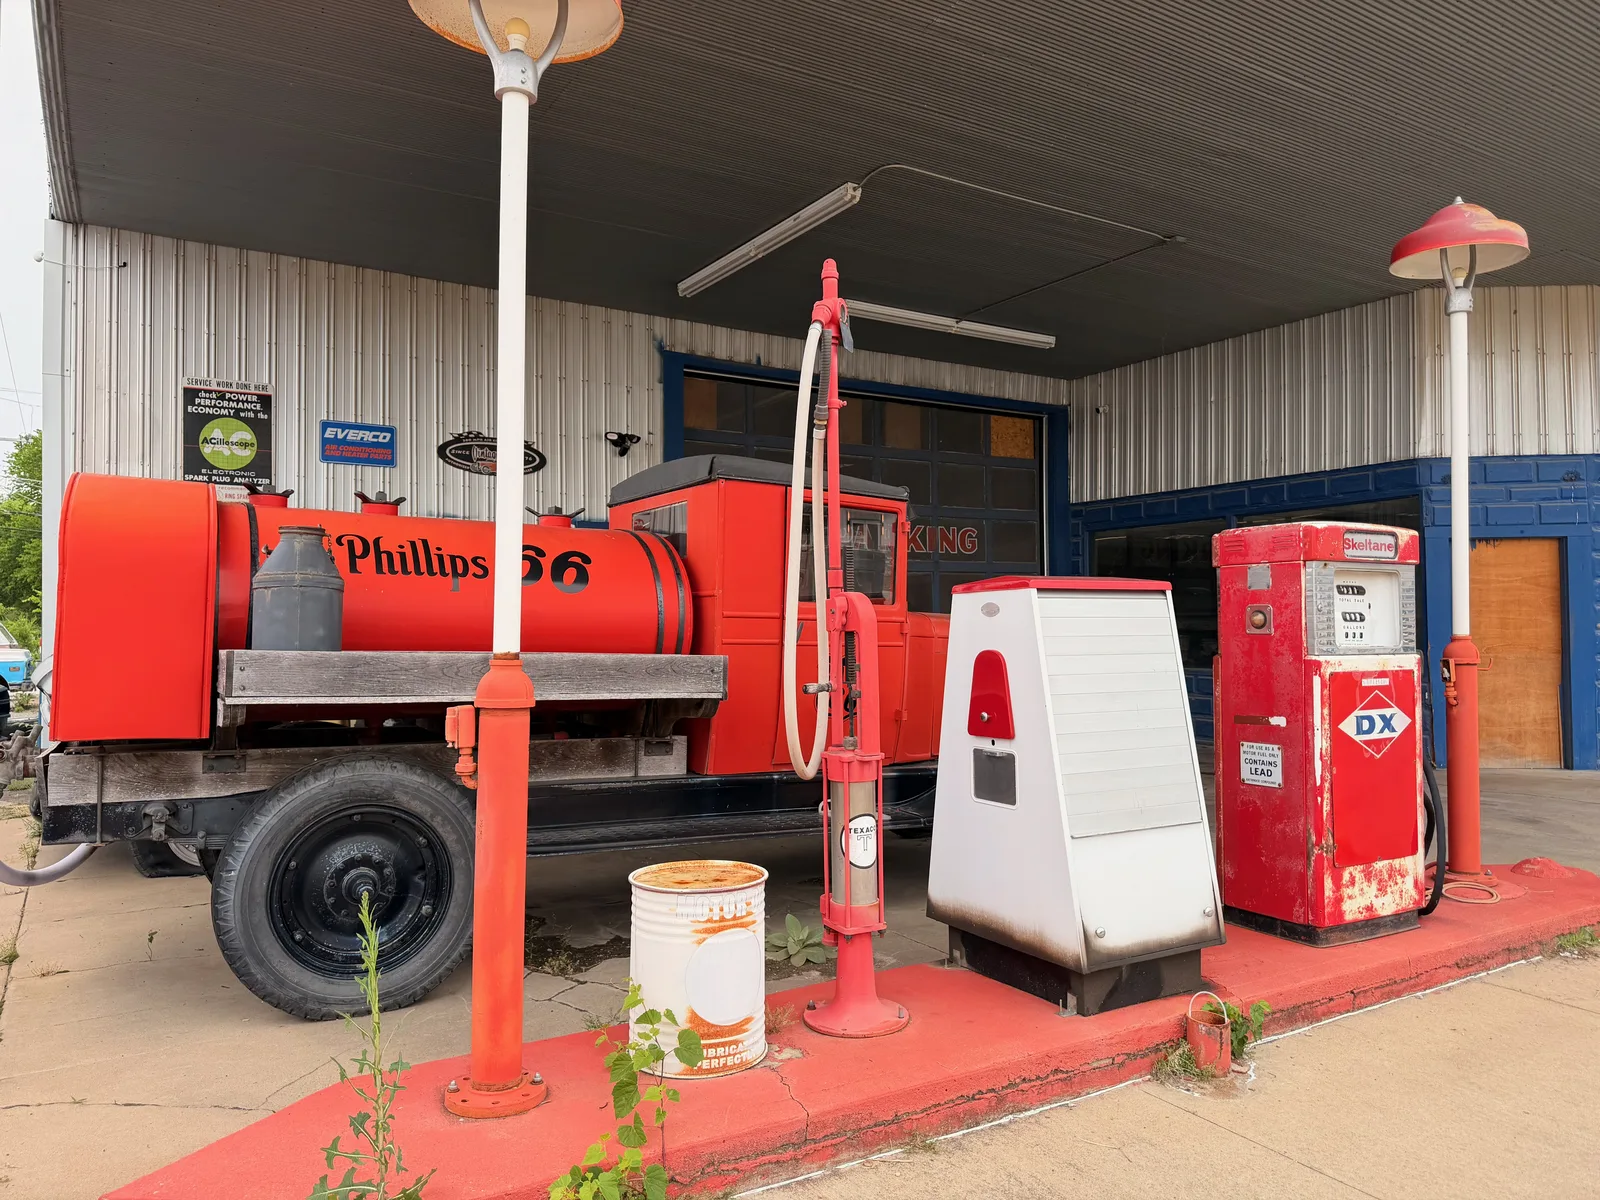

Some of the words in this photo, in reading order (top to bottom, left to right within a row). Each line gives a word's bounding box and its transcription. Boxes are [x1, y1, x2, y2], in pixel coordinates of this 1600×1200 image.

[187, 378, 212, 387] SERVICE
[216, 380, 233, 389] WORK
[236, 382, 251, 391] DONE
[254, 384, 269, 392] HERE
[188, 406, 235, 416] ECONOMY
[324, 427, 391, 443] EVERCO
[201, 436, 255, 449] ACilloscope
[339, 445, 392, 454] CONDITIONING
[1343, 537, 1395, 552] Skeltane
[335, 534, 490, 592] Phillips
[521, 544, 592, 594] 66
[1354, 713, 1397, 736] DX
[1244, 758, 1278, 768] CONTAINS
[1250, 767, 1273, 777] LEAD
[676, 892, 748, 921] MOTOR
